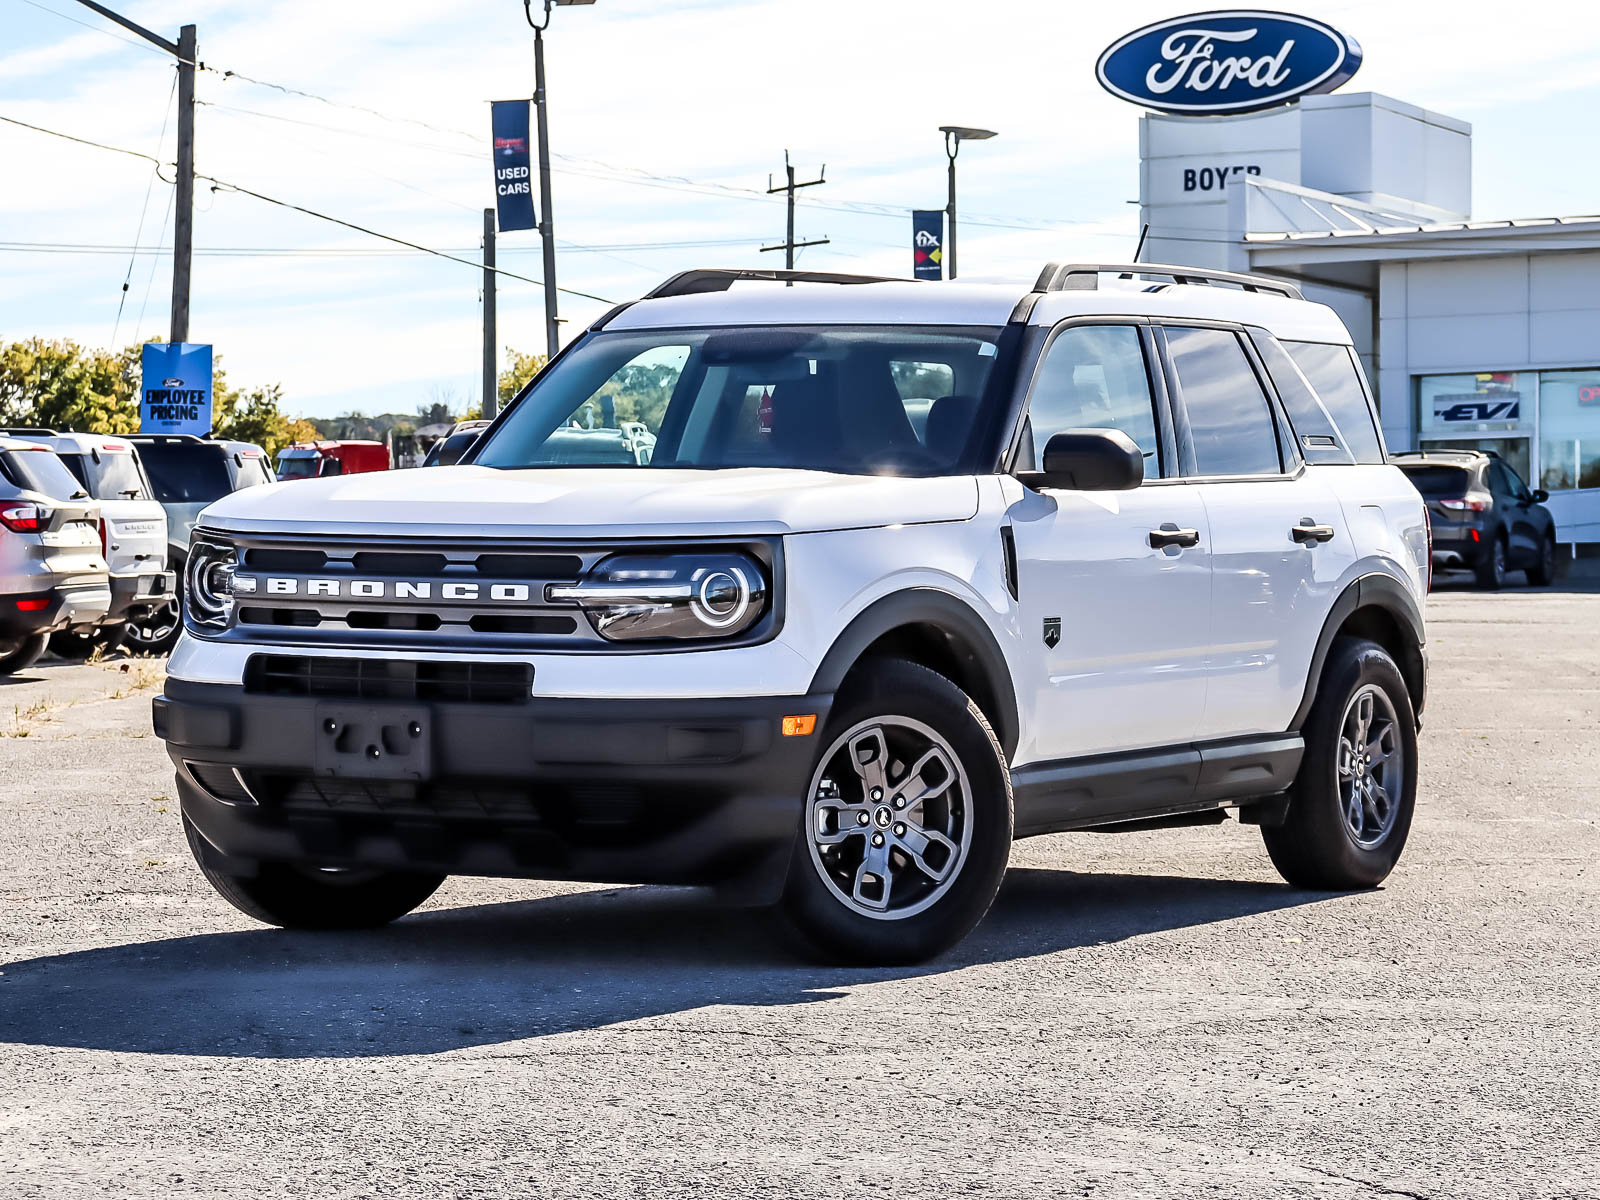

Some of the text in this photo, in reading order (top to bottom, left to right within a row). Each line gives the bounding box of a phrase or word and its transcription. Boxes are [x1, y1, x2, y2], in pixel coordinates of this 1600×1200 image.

[1145, 28, 1295, 94] Ford
[497, 166, 529, 180] USED
[498, 181, 530, 196] CARS
[915, 230, 941, 247] fix
[145, 389, 206, 405] EMPLOYEE
[150, 404, 198, 421] PRICING
[266, 577, 530, 601] BRONCO
